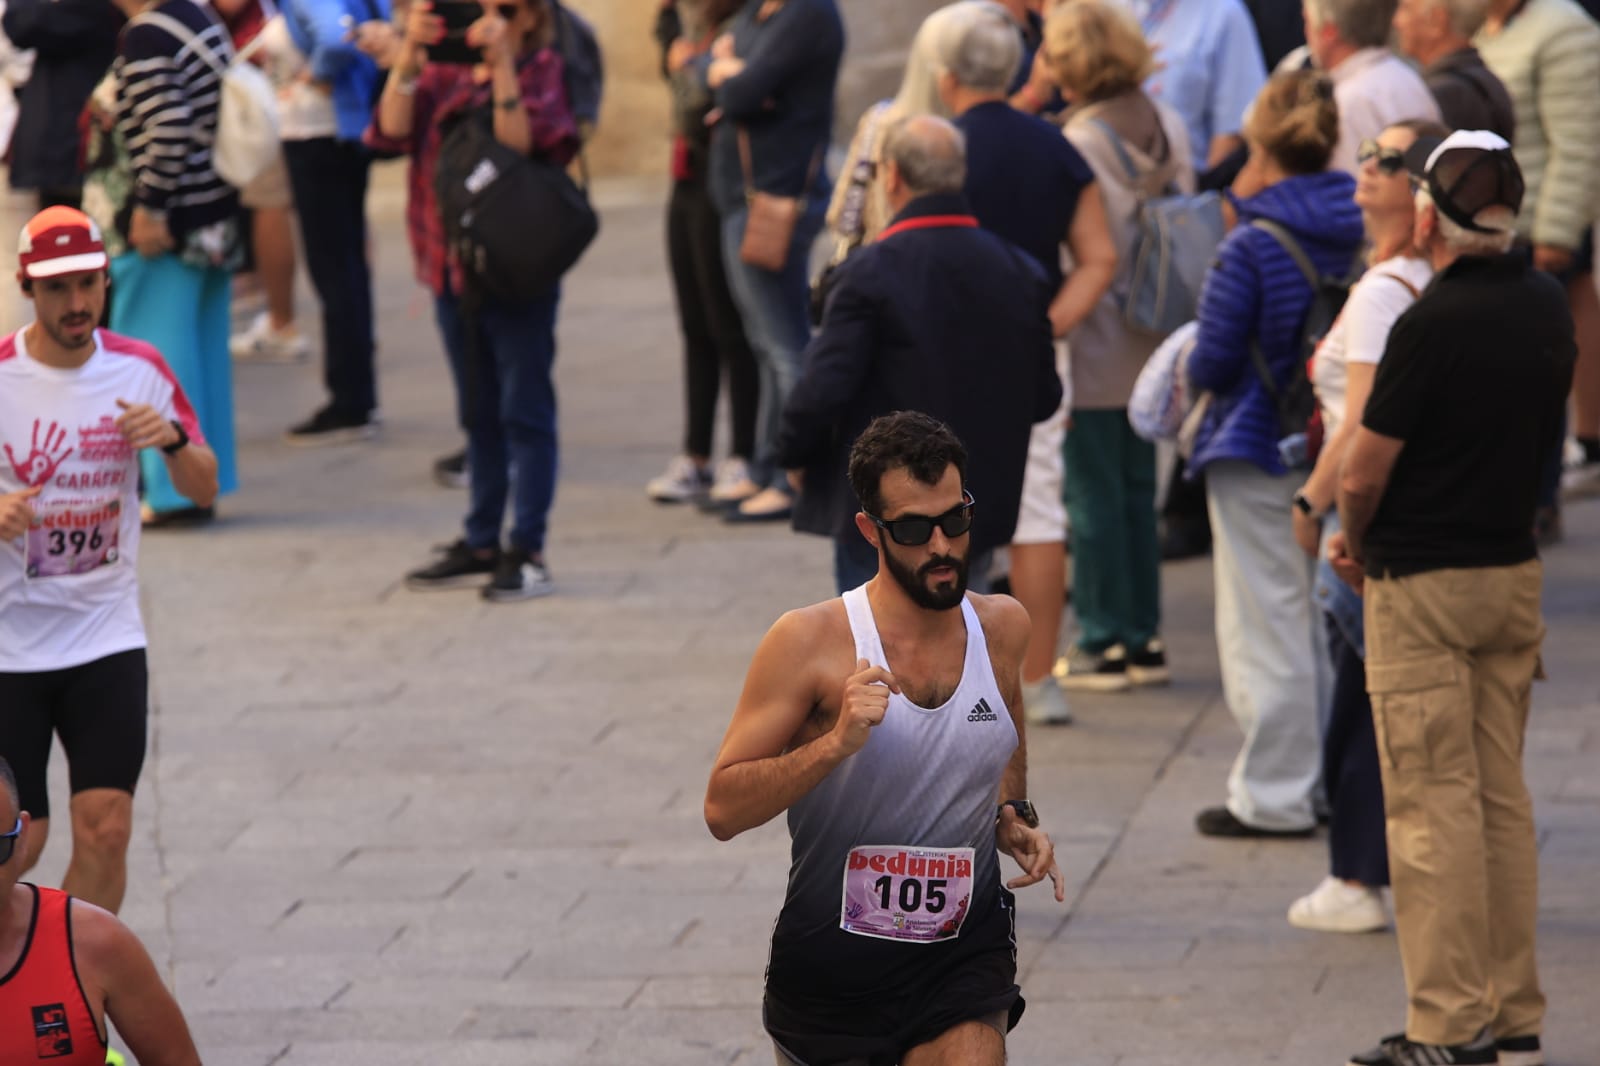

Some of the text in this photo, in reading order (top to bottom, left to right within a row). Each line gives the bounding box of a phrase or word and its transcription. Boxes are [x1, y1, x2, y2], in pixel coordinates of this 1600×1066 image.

[48, 528, 103, 556] 396
[967, 713, 998, 722] adidas
[849, 851, 971, 878] bedunia
[875, 875, 948, 915] 105
